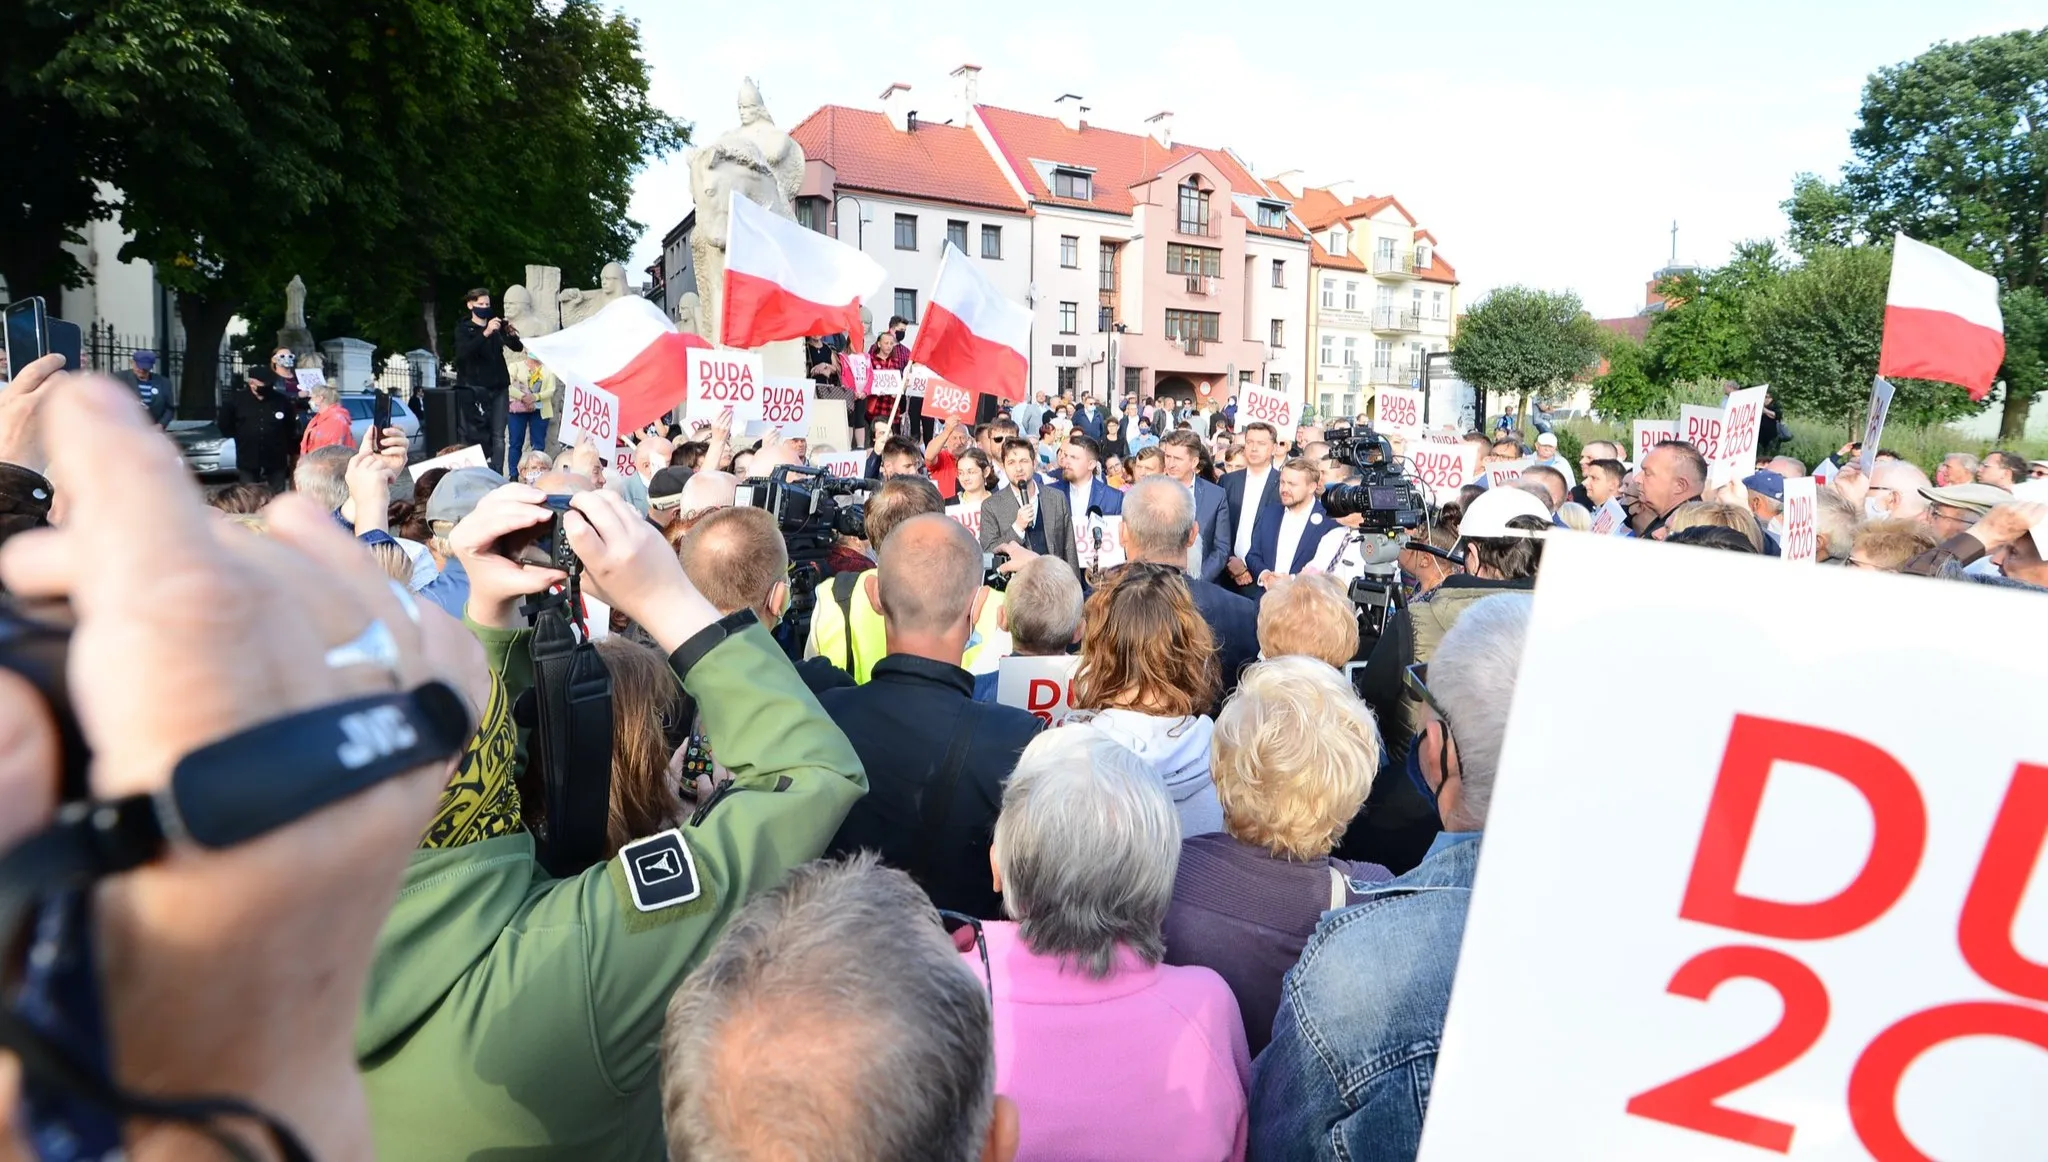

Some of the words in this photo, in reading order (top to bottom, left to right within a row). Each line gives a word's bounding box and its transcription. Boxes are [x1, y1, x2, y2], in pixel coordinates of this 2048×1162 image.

[699, 360, 753, 382] DUDA
[874, 373, 896, 381] DUDA
[700, 380, 754, 401] 2020
[874, 380, 898, 388] 2020
[933, 385, 971, 403] DUDA
[573, 386, 611, 422] DUDA
[763, 386, 804, 405] DUDA
[931, 397, 971, 413] 2020
[1248, 391, 1290, 415] DUDA
[1381, 393, 1416, 413] DUDA
[571, 406, 610, 439] 2020
[763, 405, 804, 421] 2020
[1246, 404, 1290, 426] 2020
[1381, 409, 1416, 426] 2020
[1726, 402, 1757, 434] DUDA
[1688, 416, 1721, 440] DUD
[1722, 427, 1753, 460] 2020
[826, 460, 858, 478] DUDA
[1415, 451, 1463, 473] DUDA
[1413, 469, 1463, 488] 2020
[1789, 495, 1813, 530] DUDA
[1787, 528, 1813, 560] 2020
